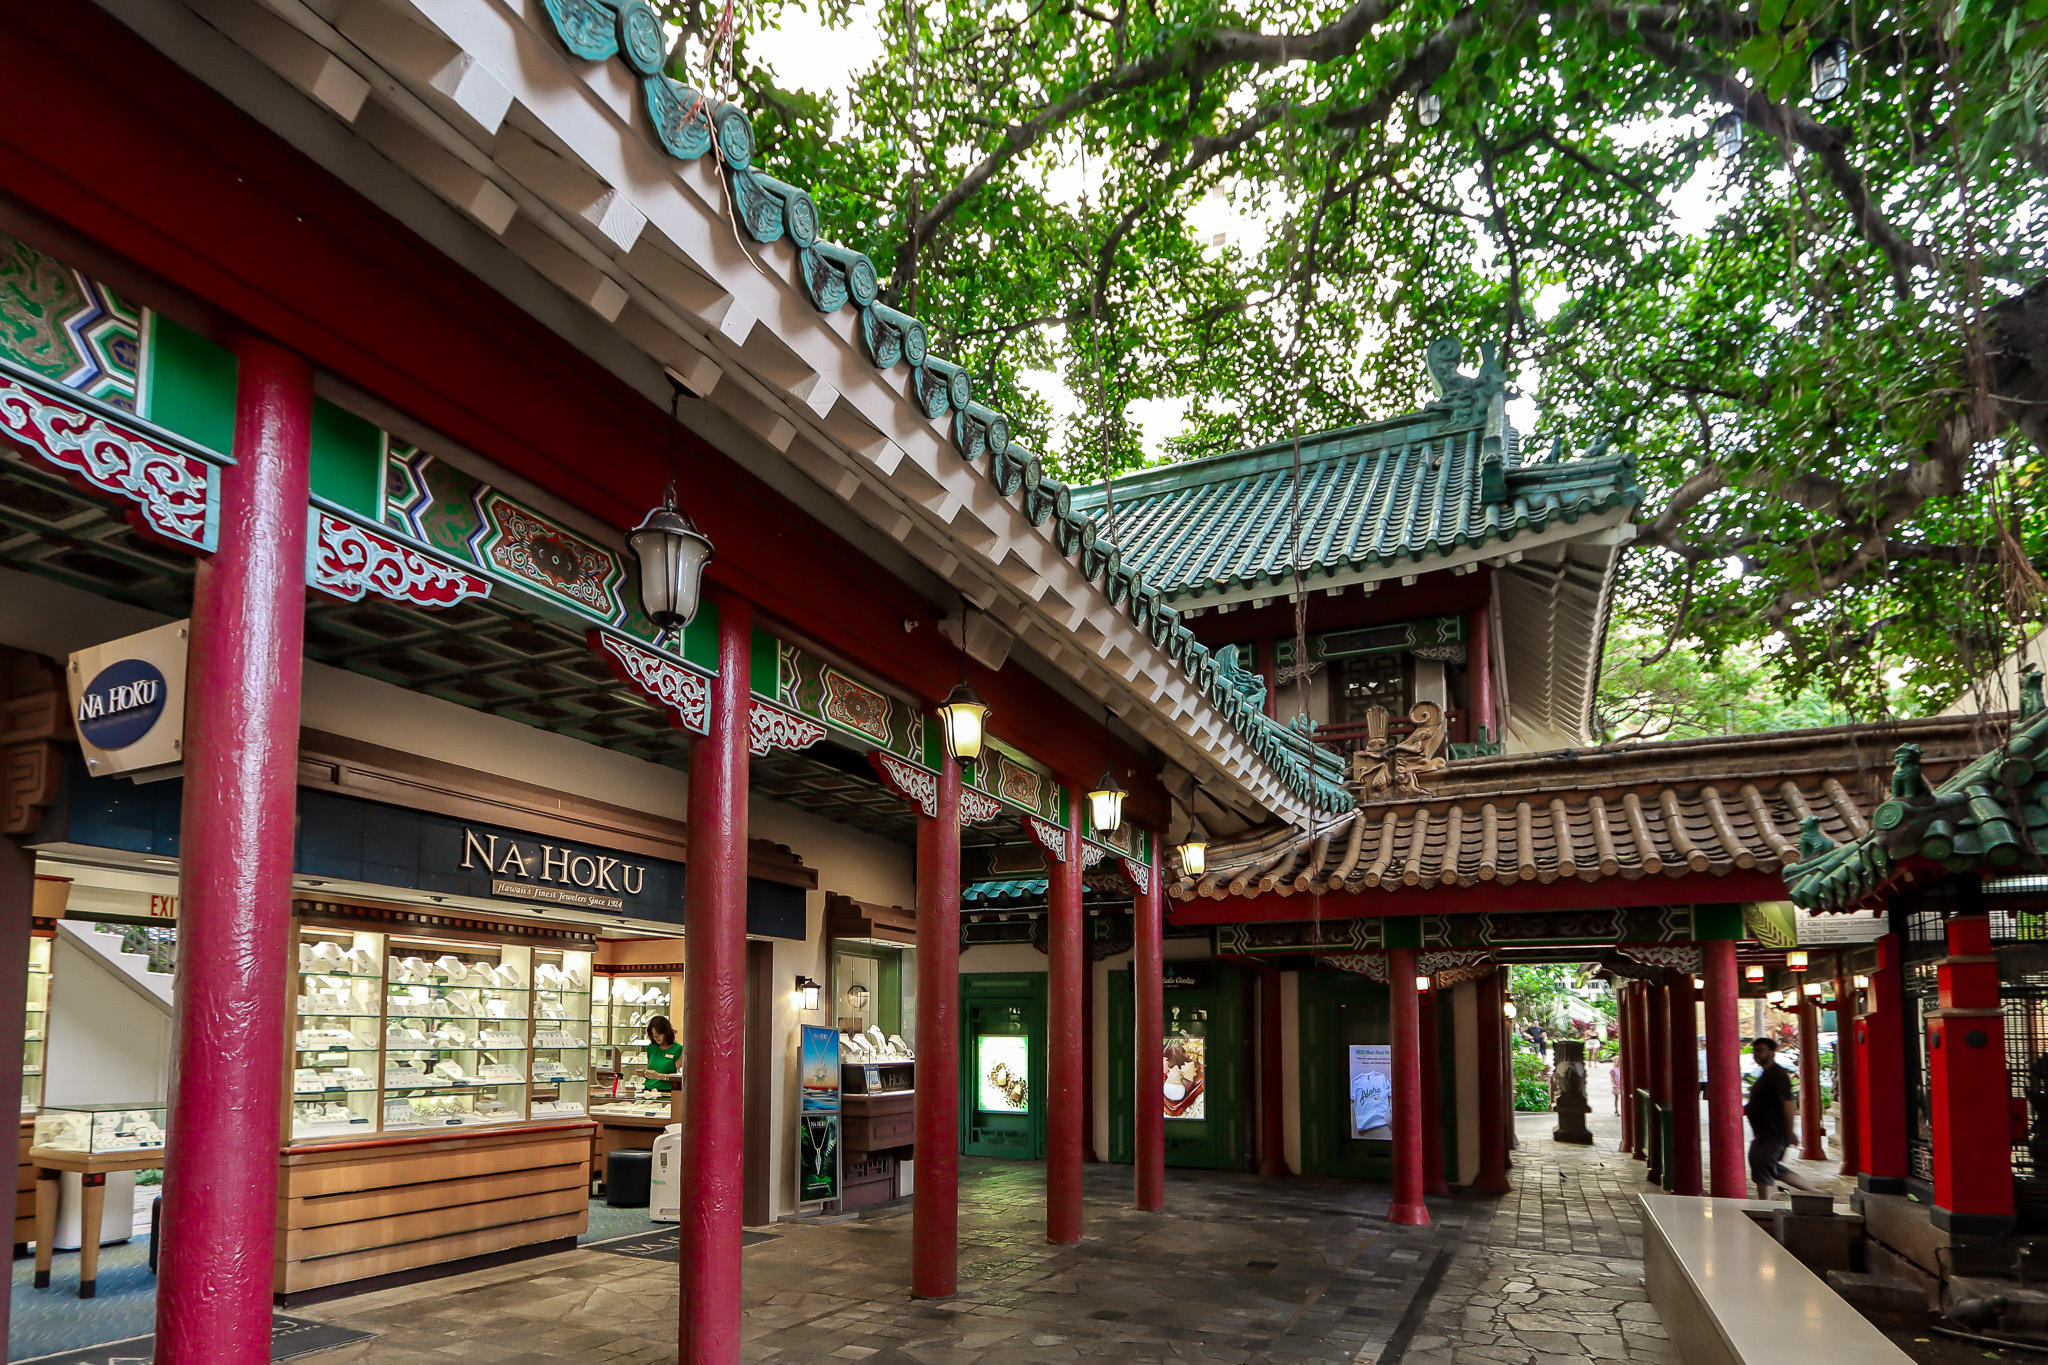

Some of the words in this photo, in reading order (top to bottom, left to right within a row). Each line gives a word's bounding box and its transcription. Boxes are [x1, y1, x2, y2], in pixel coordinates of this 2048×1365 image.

[79, 694, 105, 720] NA
[109, 680, 159, 713] HOKU
[460, 827, 529, 877] NA
[539, 844, 646, 894] HOKU
[151, 895, 178, 917] EXI
[496, 882, 532, 894] Hawaii's
[532, 887, 557, 899] Finest
[558, 891, 587, 902] Jewelers
[587, 895, 606, 907] Since
[607, 899, 623, 908] 1924
[1175, 976, 1196, 985] Cookie
[1360, 1085, 1381, 1105] Aloha
